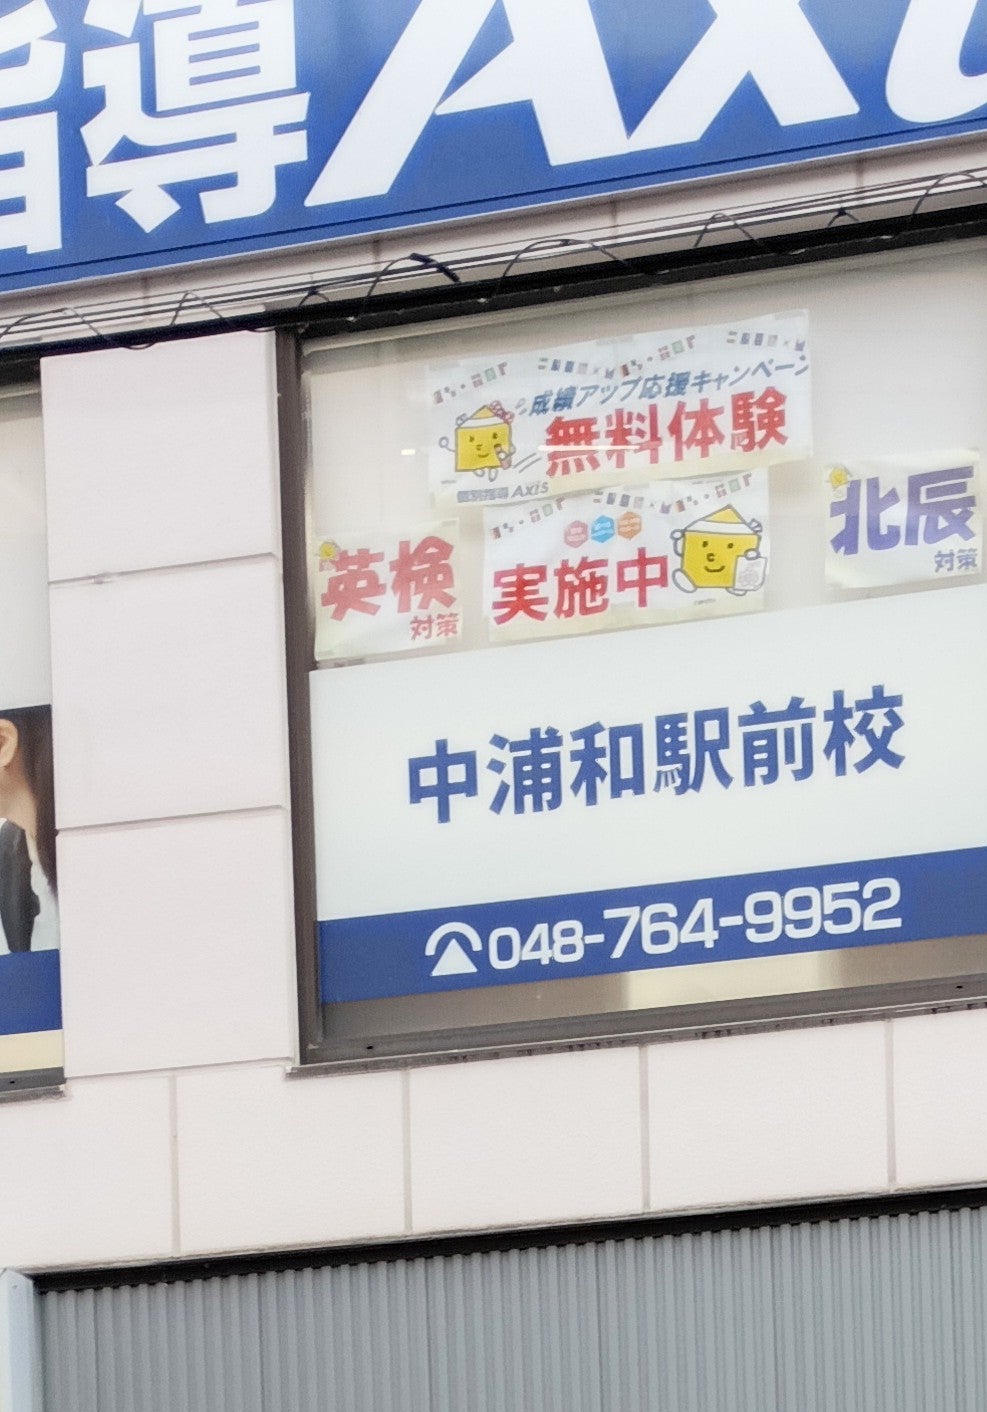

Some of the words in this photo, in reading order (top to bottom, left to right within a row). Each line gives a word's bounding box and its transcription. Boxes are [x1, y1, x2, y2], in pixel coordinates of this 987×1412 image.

[0, 0, 311, 254] 導
[527, 354, 810, 417] 成績アップ応援キャンペーン
[545, 385, 789, 478] 無料体験
[829, 465, 977, 556] 北辰
[320, 535, 458, 621] 英検
[491, 547, 669, 625] 実施中
[934, 547, 978, 574] 対策
[409, 612, 460, 641] 対策
[407, 684, 907, 825] 中浦和駅前校
[487, 877, 903, 971] 048-764-9952
